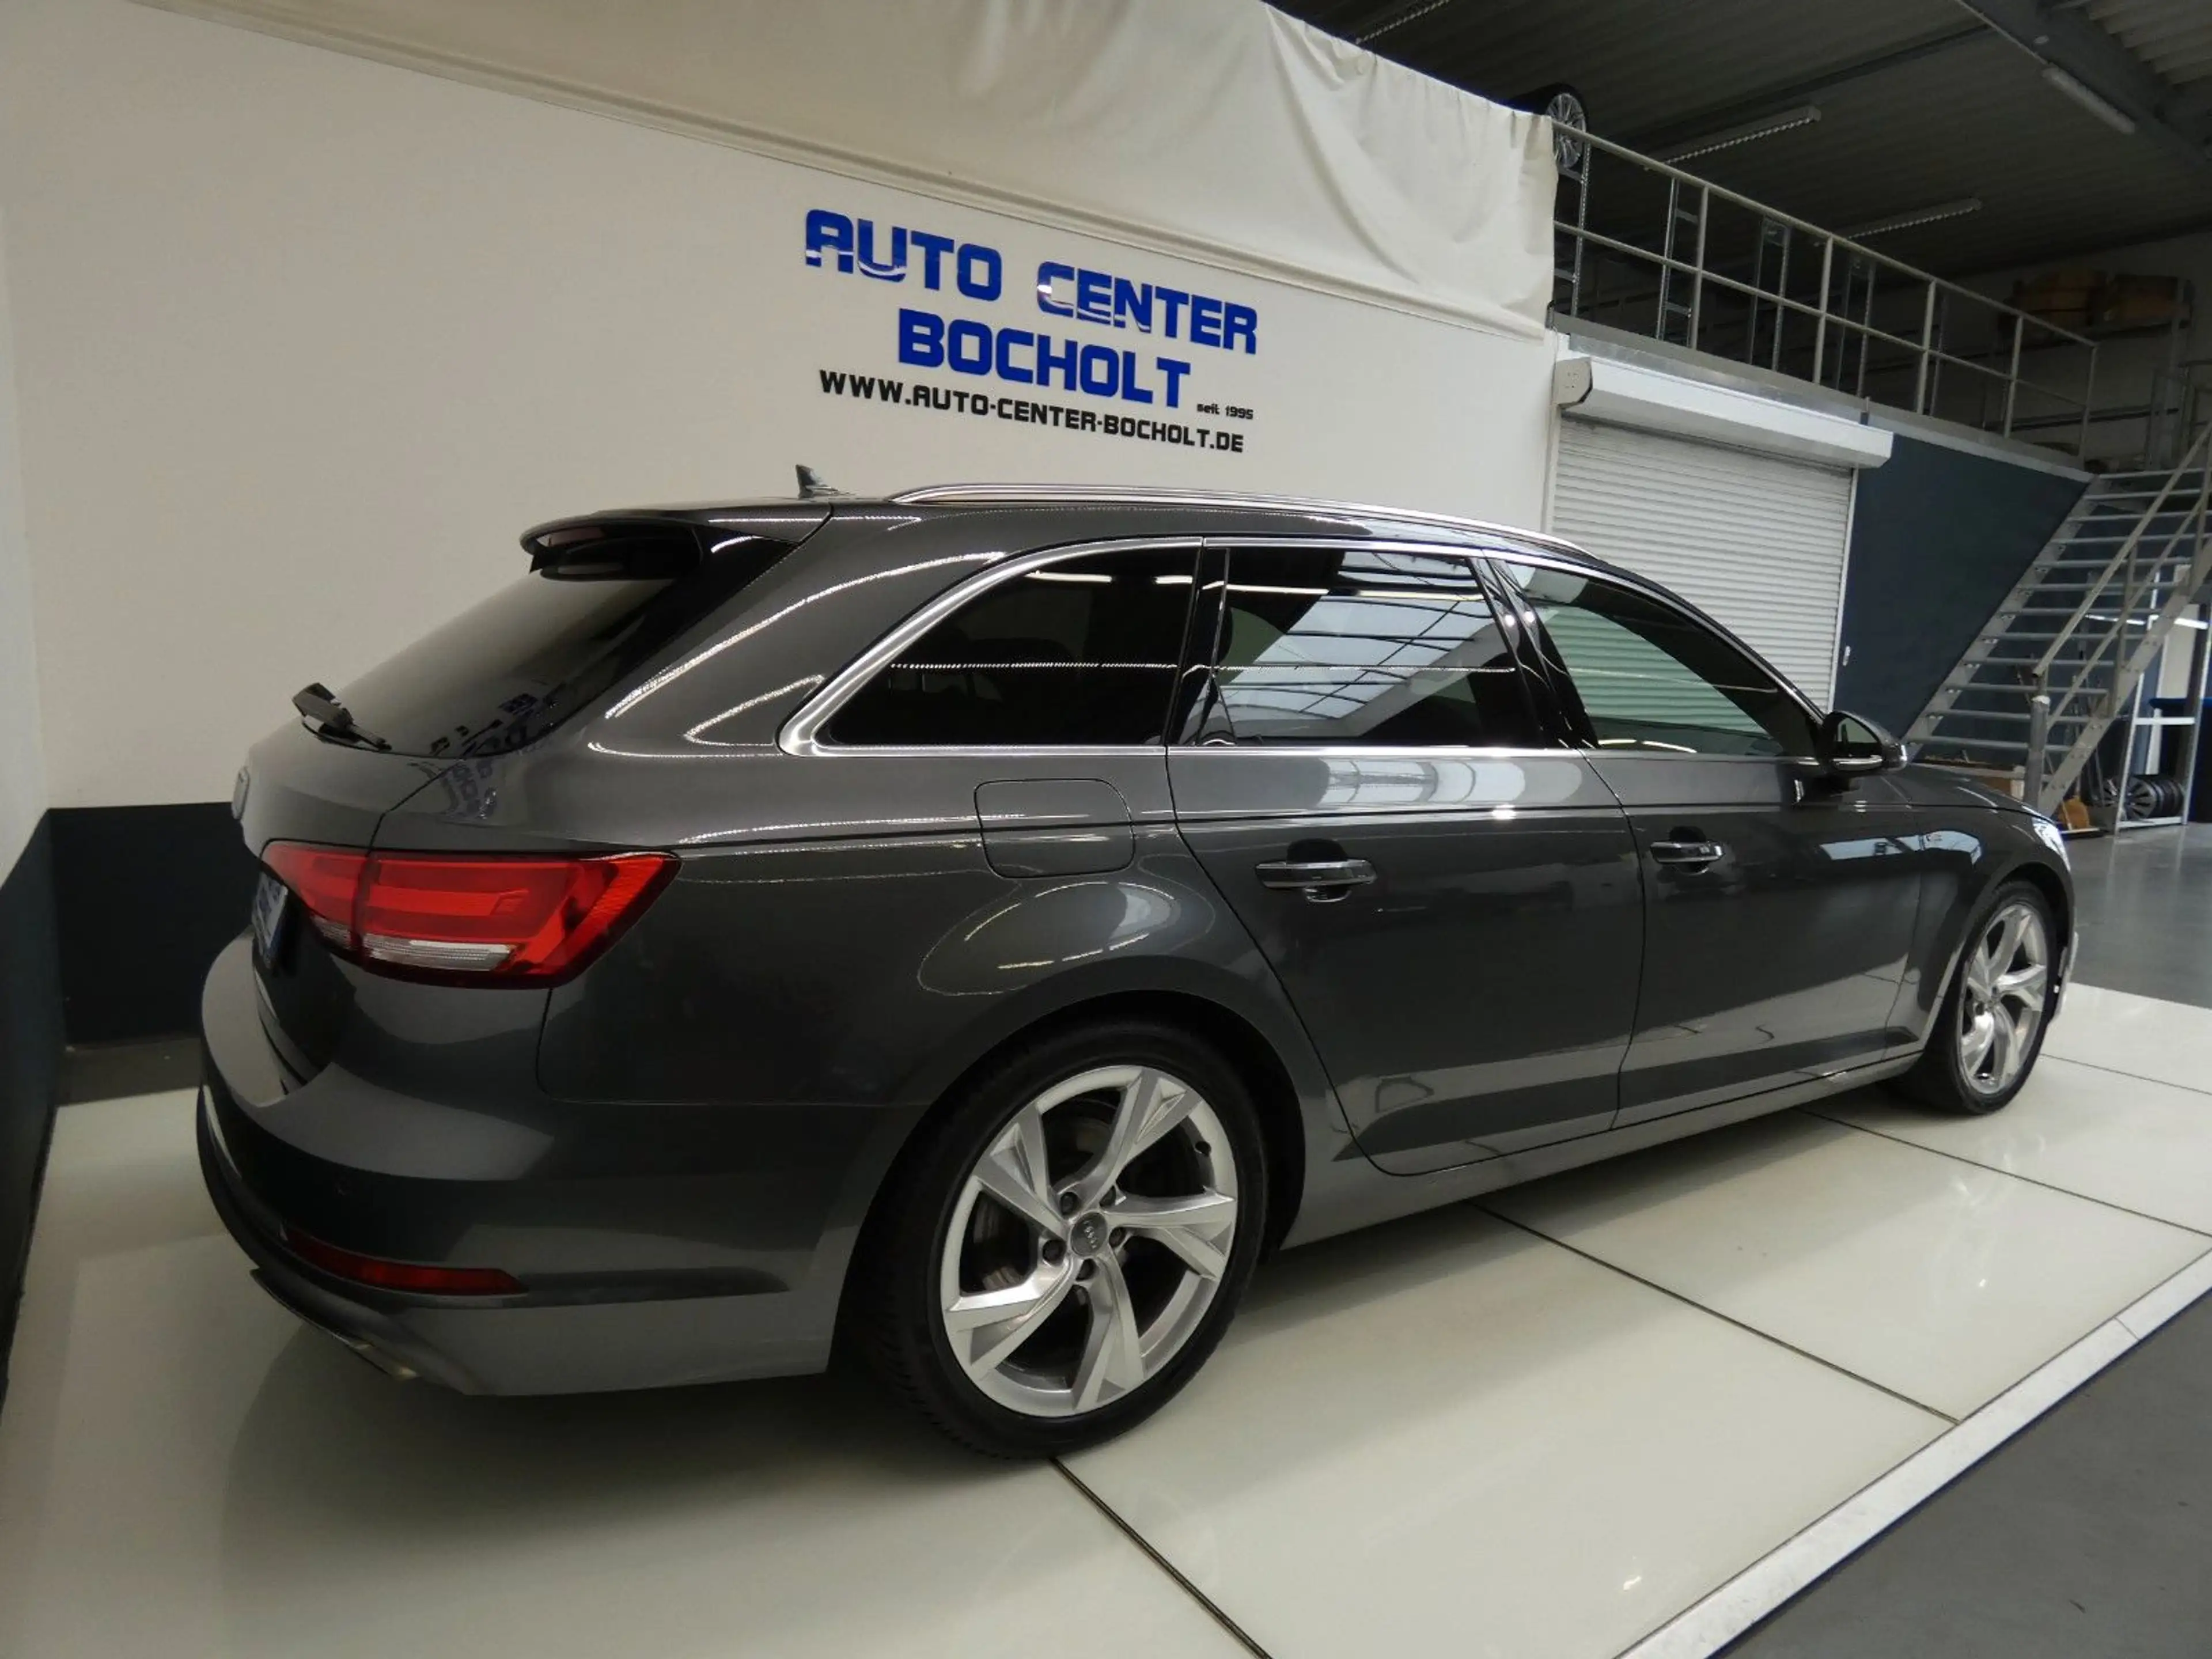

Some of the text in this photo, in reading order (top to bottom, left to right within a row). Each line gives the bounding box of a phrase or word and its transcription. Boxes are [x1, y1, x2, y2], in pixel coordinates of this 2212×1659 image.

[806, 209, 1258, 355] AUTO CENTER
[899, 308, 1191, 408] BOCHOLT
[820, 369, 1244, 453] WWW.AUTO-CENTER-BOCHOLT.DE
[1225, 405, 1254, 420] 1995
